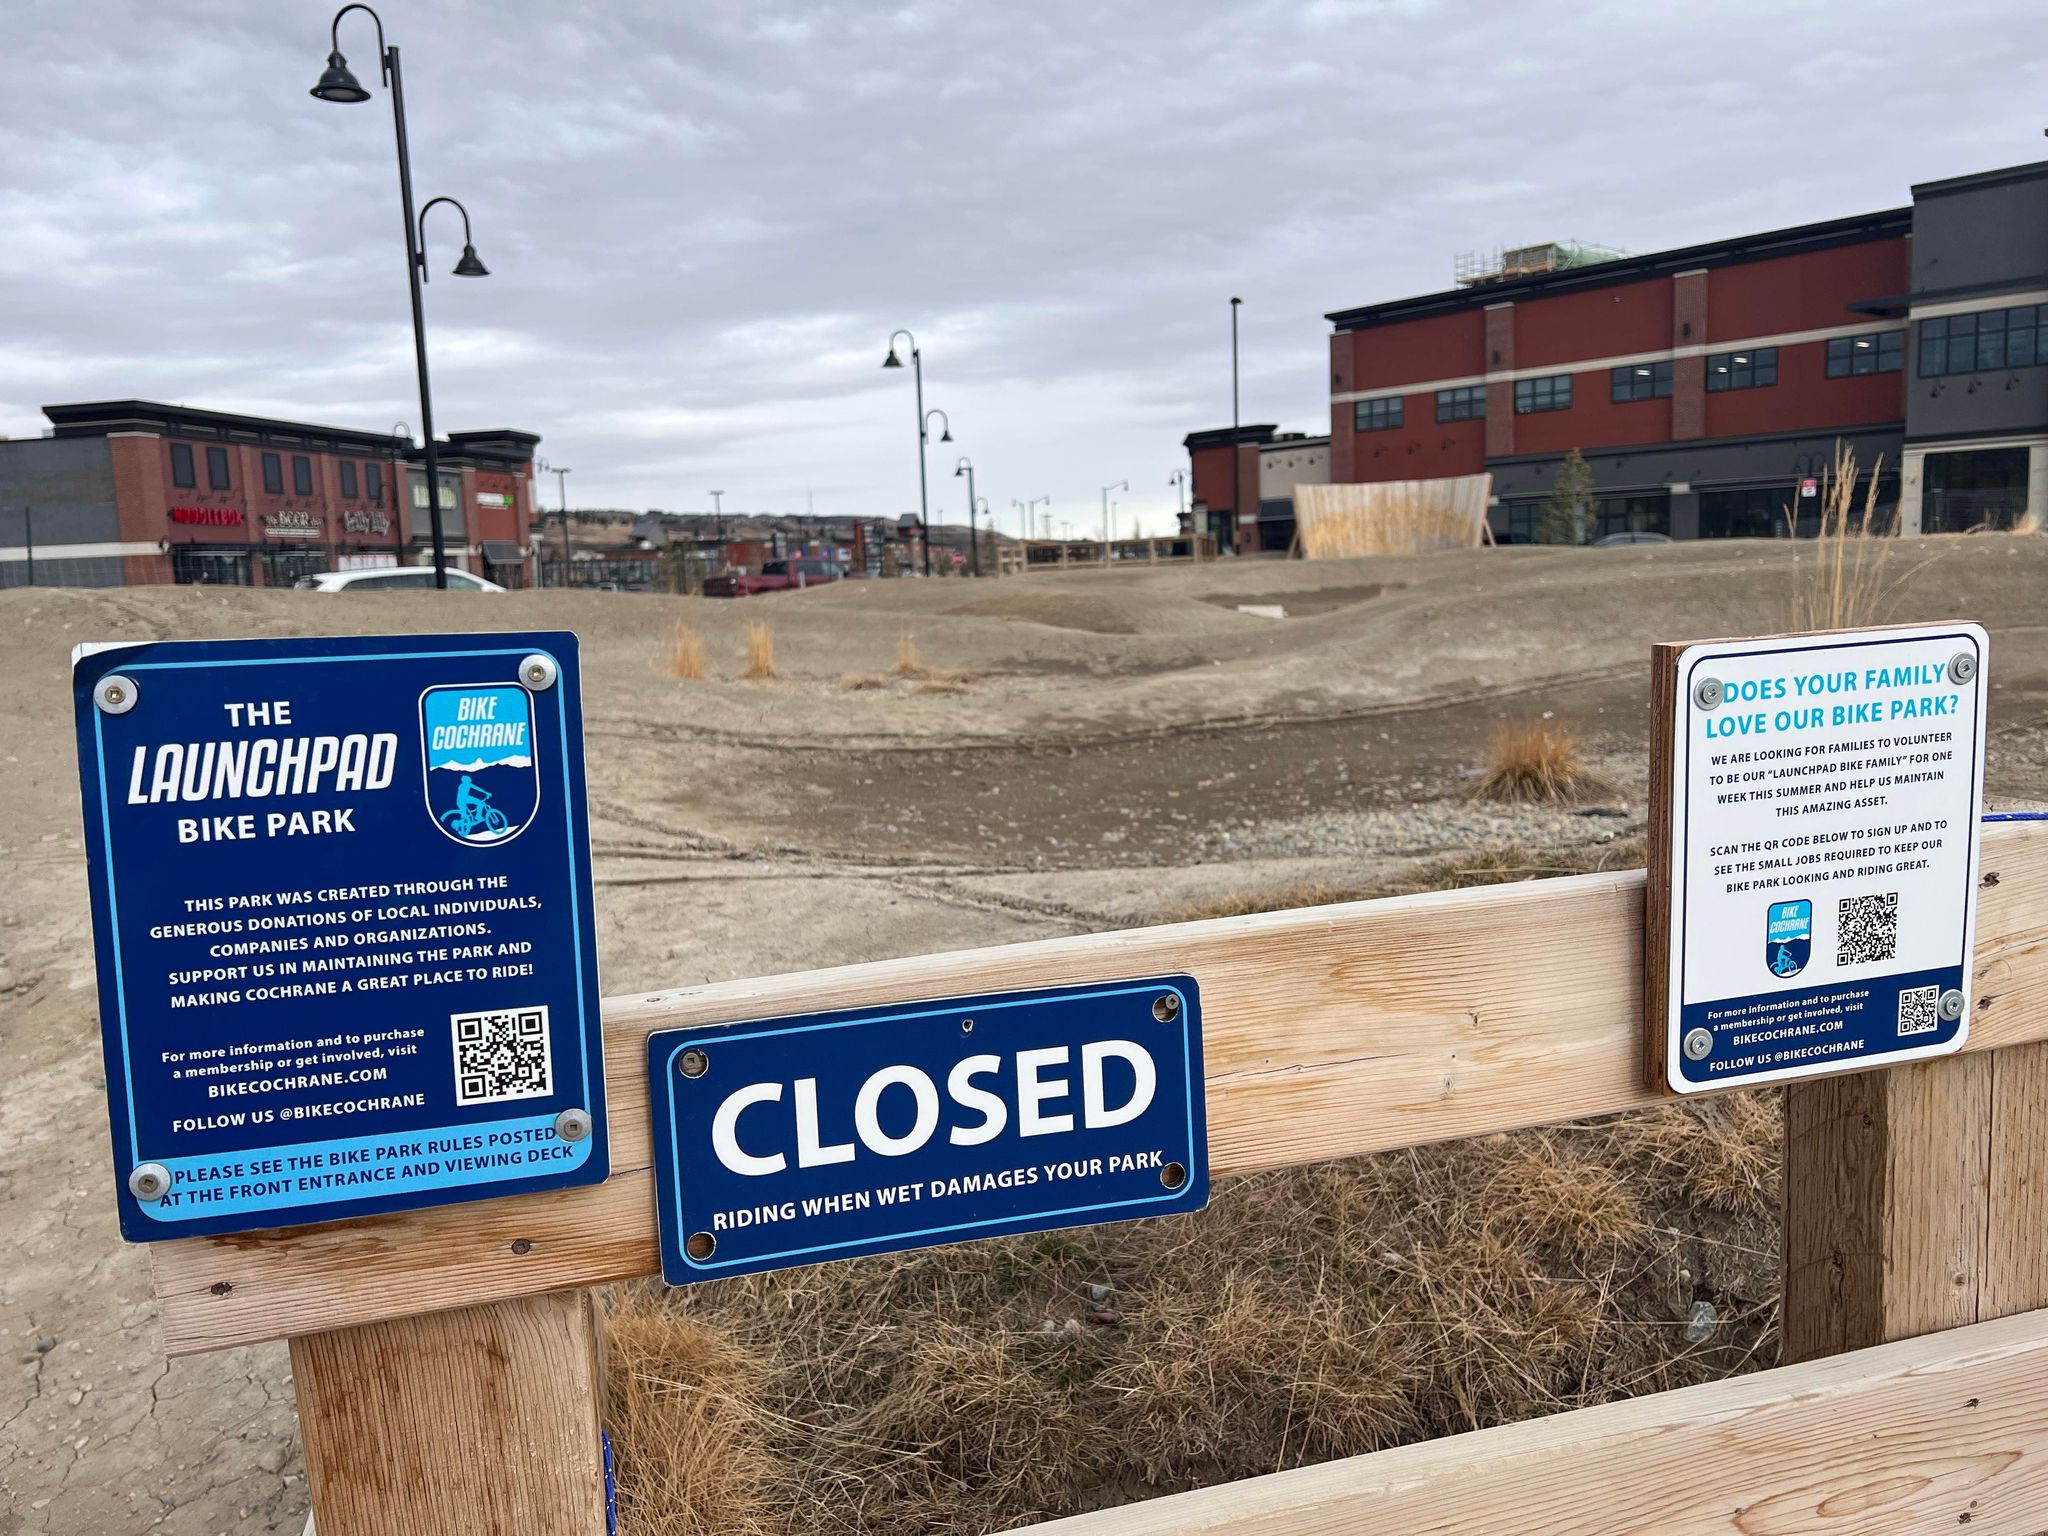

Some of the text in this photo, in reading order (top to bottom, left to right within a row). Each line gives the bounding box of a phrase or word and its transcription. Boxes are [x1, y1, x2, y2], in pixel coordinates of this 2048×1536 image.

[1722, 663, 1946, 704] DOES YOUR FAMILY
[224, 701, 291, 727] THE
[458, 697, 497, 720] BIKE
[1706, 694, 1958, 738] LOVE OUR BIKE PARK?
[433, 723, 525, 750] COCHRANE
[1711, 732, 1952, 766] WE ARE LOOKING FOR FAMILIES TO VOLUNTEER
[128, 733, 397, 804] LAUNCHPAD
[1709, 775, 1723, 785] TO
[1727, 773, 1739, 784] BE
[1743, 771, 1765, 782] OUR
[1840, 760, 1863, 771] BIKE
[1909, 753, 1929, 764] FOR
[1932, 751, 1952, 761] ONE
[1717, 771, 1944, 804] WEEK THIS SUMMER AND HELP US MAINTAIN
[1776, 796, 1888, 817] THIS AMAZING ASSET.
[178, 809, 355, 843] BIKE PARK
[1710, 820, 1947, 857] SCAN THE QR CODE BELOW TO SIGN UP AND TO
[1714, 839, 1942, 875] SEE THE SMALL JOBS REQUIRED TO KEEP OUR
[1727, 859, 1929, 893] BIKE PARK LOOKING AND RIDING GREAT.
[184, 876, 508, 912] THIS PARK WAS CREATED THROUGH THE
[150, 896, 542, 938] GENEROUS DONATIONS OF LOCAL INDIVIDUALS,
[1769, 916, 1810, 934] COCHRANE
[1780, 905, 1799, 919] BIKE
[210, 923, 491, 957] COMPANIES AND ORGANIZATIONS.
[169, 942, 531, 985] SUPPORT US IN MAINTAINING THE PARK AND
[171, 964, 533, 1008] MAKING COCHRANE A GREAT PLACE TO RIDE!
[1708, 991, 1869, 1019] For more information and to purchase
[1713, 1023, 1719, 1032] a
[1721, 1016, 1775, 1030] membership
[1788, 1012, 1802, 1022] get
[1845, 1002, 1863, 1012] visit
[162, 1029, 424, 1062] For more information and to purchase
[1733, 1020, 1843, 1045] BIKECOCHRANE.COM
[185, 1059, 273, 1077] membership
[277, 1059, 292, 1068] or
[296, 1055, 318, 1068] get
[322, 1047, 384, 1063] involved,
[388, 1044, 417, 1056] visit
[1710, 1056, 1754, 1072] FOLLOW
[1758, 1054, 1771, 1064] US
[208, 1068, 387, 1098] BIKECOCHRANE.COM
[173, 1093, 425, 1132] FOLLOW US @BIKECOCHRANE
[712, 1040, 1156, 1176] CLOSED
[174, 1127, 556, 1184] PLEASE SEE THE BIKE PARK RULES POSTED
[159, 1145, 574, 1208] AT THE FRONT ENTRANCE AND VIEWING DECK
[713, 1150, 1164, 1231] RIDING WHEN WET DAMAGES YOUR PARK
